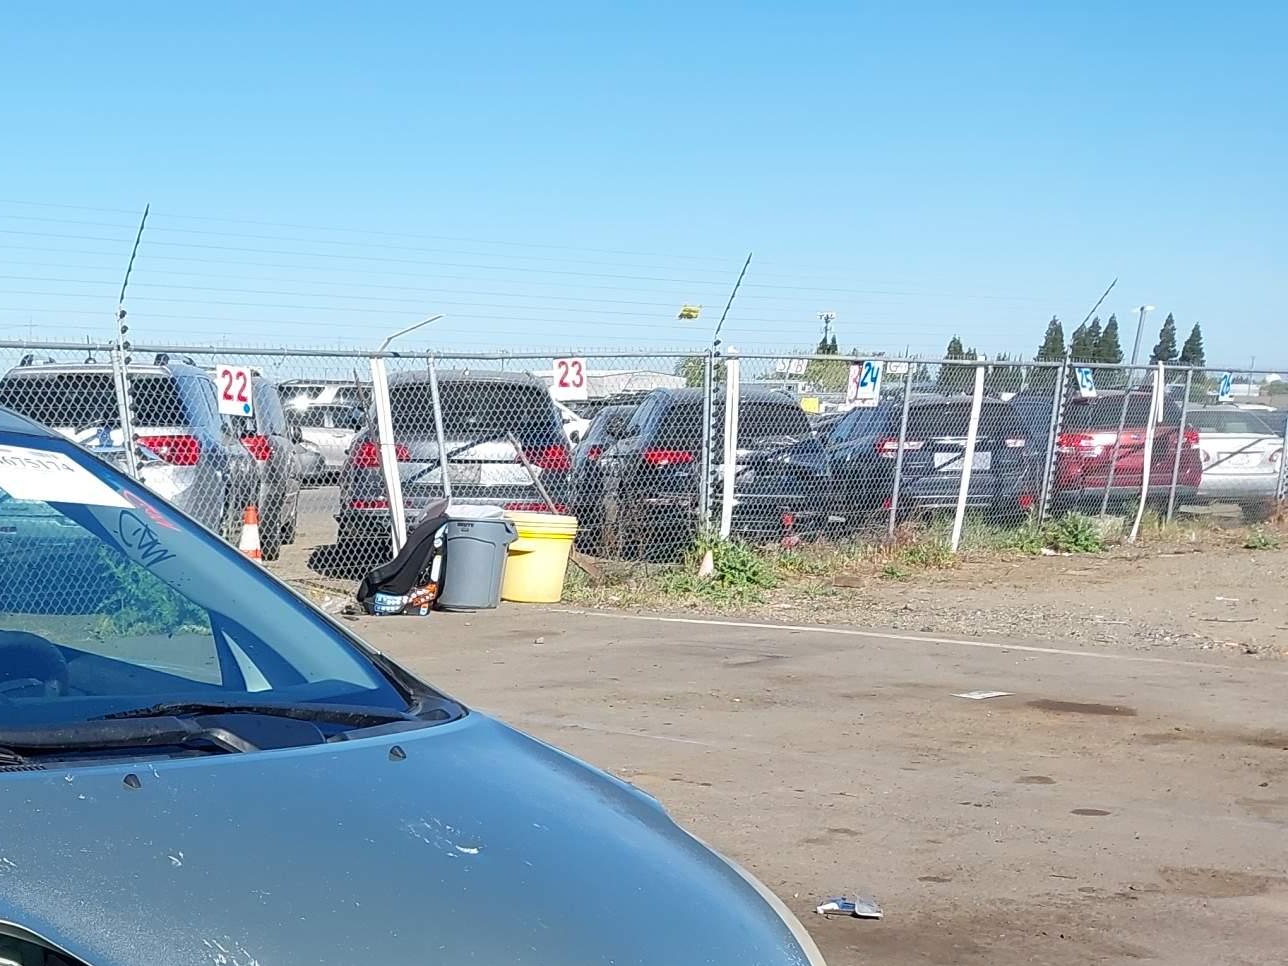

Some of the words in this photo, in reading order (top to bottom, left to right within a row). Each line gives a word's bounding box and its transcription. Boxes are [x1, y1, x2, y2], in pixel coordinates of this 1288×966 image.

[221, 369, 249, 403] 22
[558, 360, 584, 388] 23
[860, 361, 881, 392] 24
